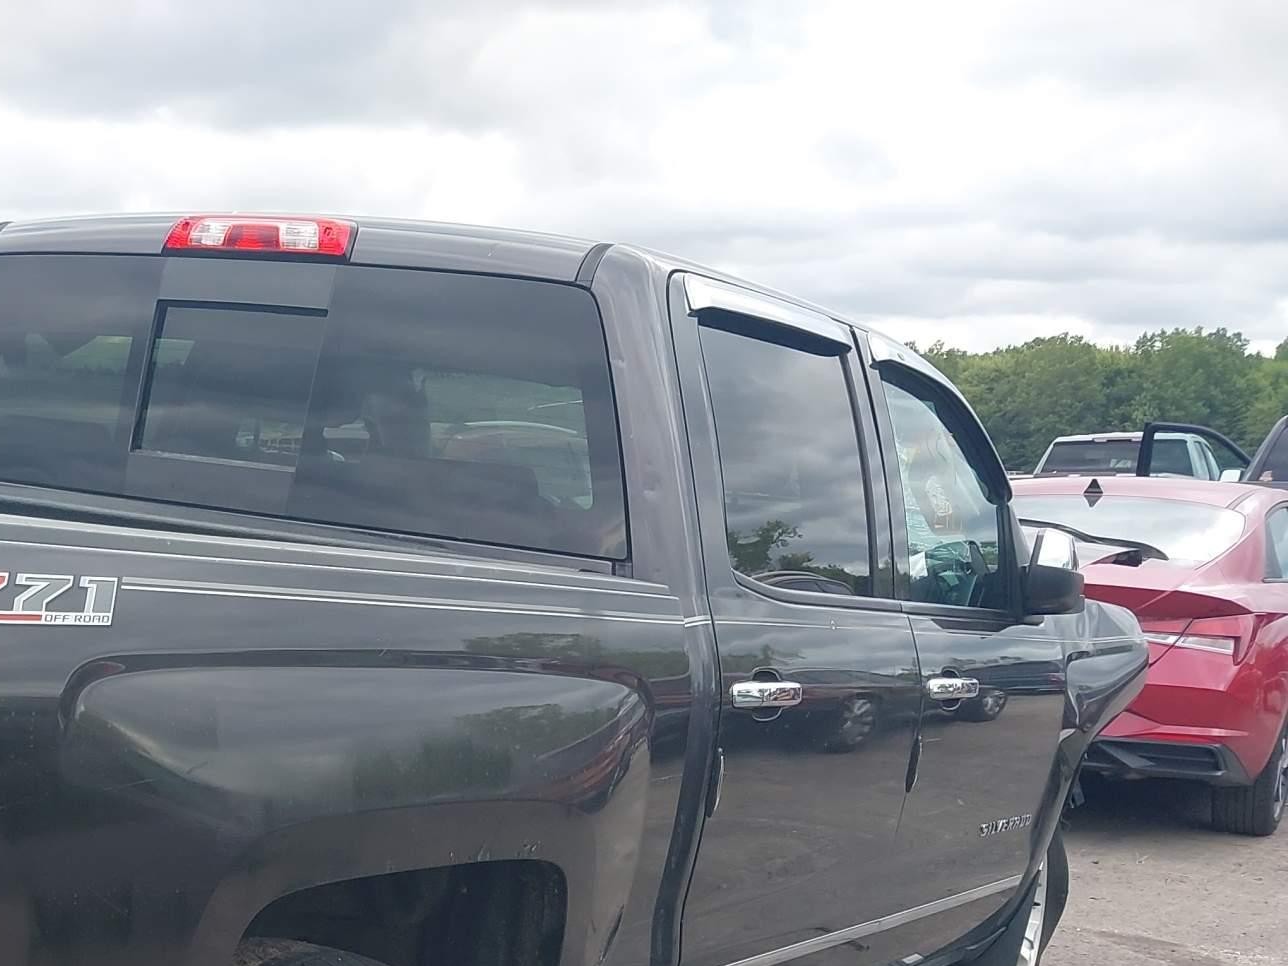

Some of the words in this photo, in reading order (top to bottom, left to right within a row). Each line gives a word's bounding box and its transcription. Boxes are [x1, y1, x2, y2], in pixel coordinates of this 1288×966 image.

[44, 613, 73, 623] OFF
[75, 615, 110, 624] ROAD
[980, 814, 1032, 837] SILVERADO
